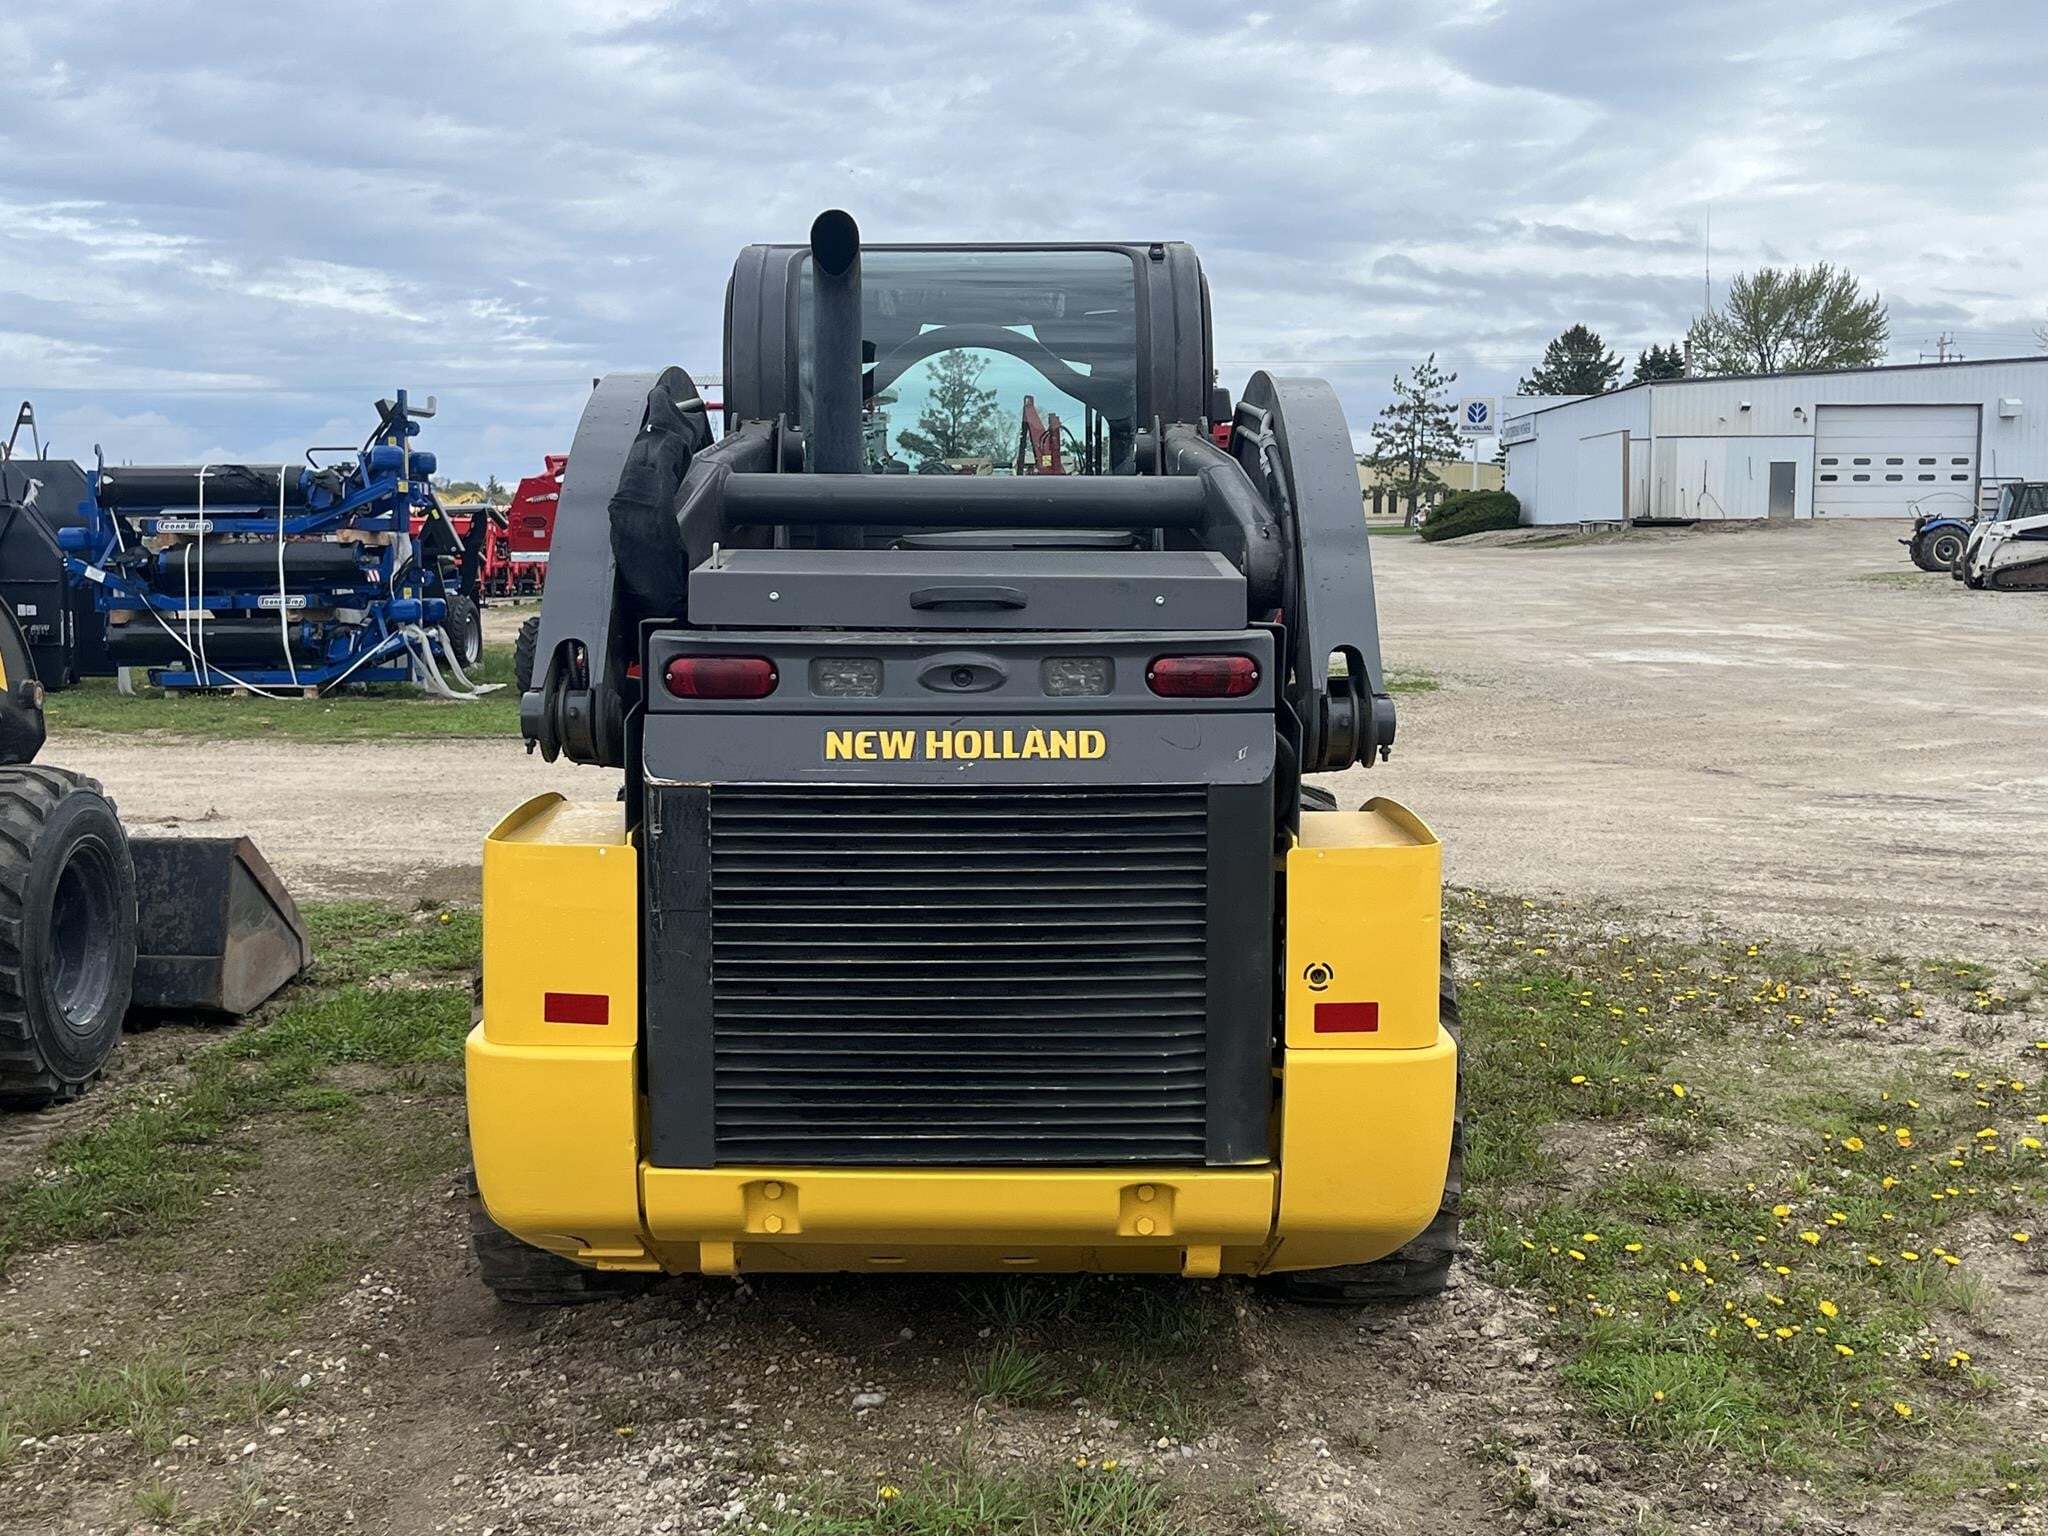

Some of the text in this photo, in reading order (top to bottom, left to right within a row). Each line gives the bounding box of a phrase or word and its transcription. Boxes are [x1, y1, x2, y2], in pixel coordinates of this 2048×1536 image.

[188, 521, 210, 531] Wrp
[825, 730, 1107, 760] NEW HOLLAND
